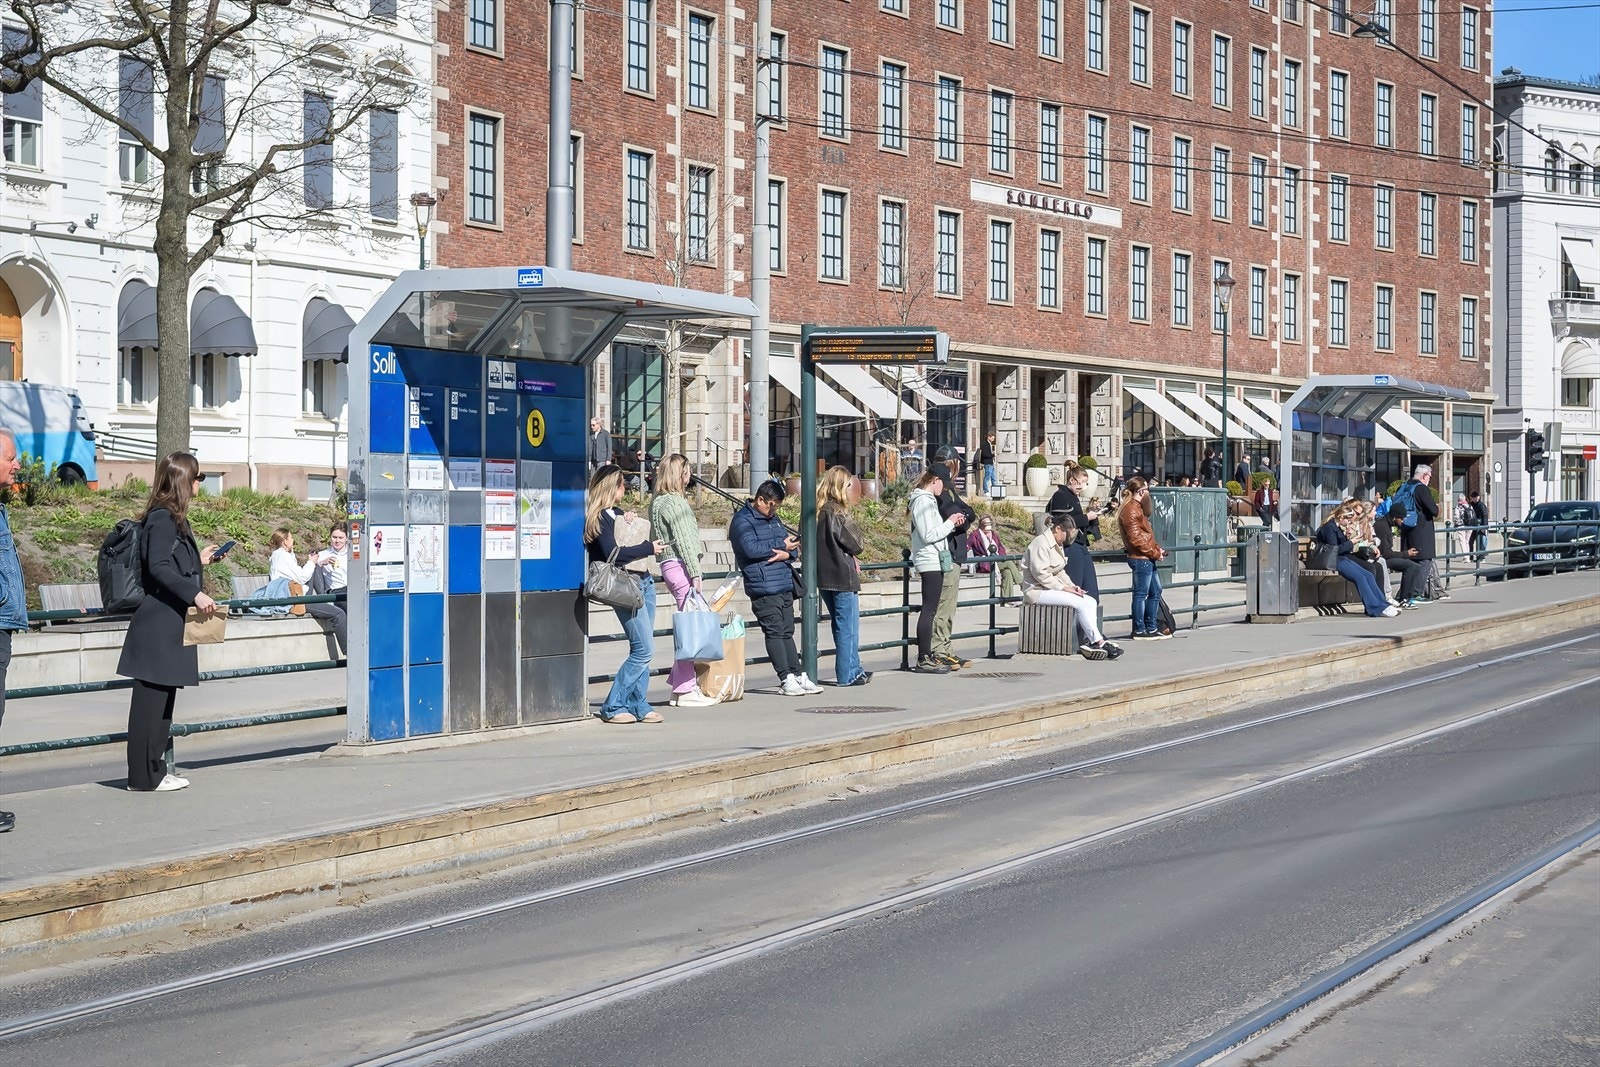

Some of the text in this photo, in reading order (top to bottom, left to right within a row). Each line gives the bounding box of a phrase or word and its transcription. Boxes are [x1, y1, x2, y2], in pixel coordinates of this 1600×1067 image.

[1007, 189, 1093, 220] SOMMERRO
[373, 352, 396, 374] Solli
[412, 388, 419, 397] 12
[412, 403, 418, 412] 13
[412, 417, 418, 426] 15
[532, 417, 540, 438] B
